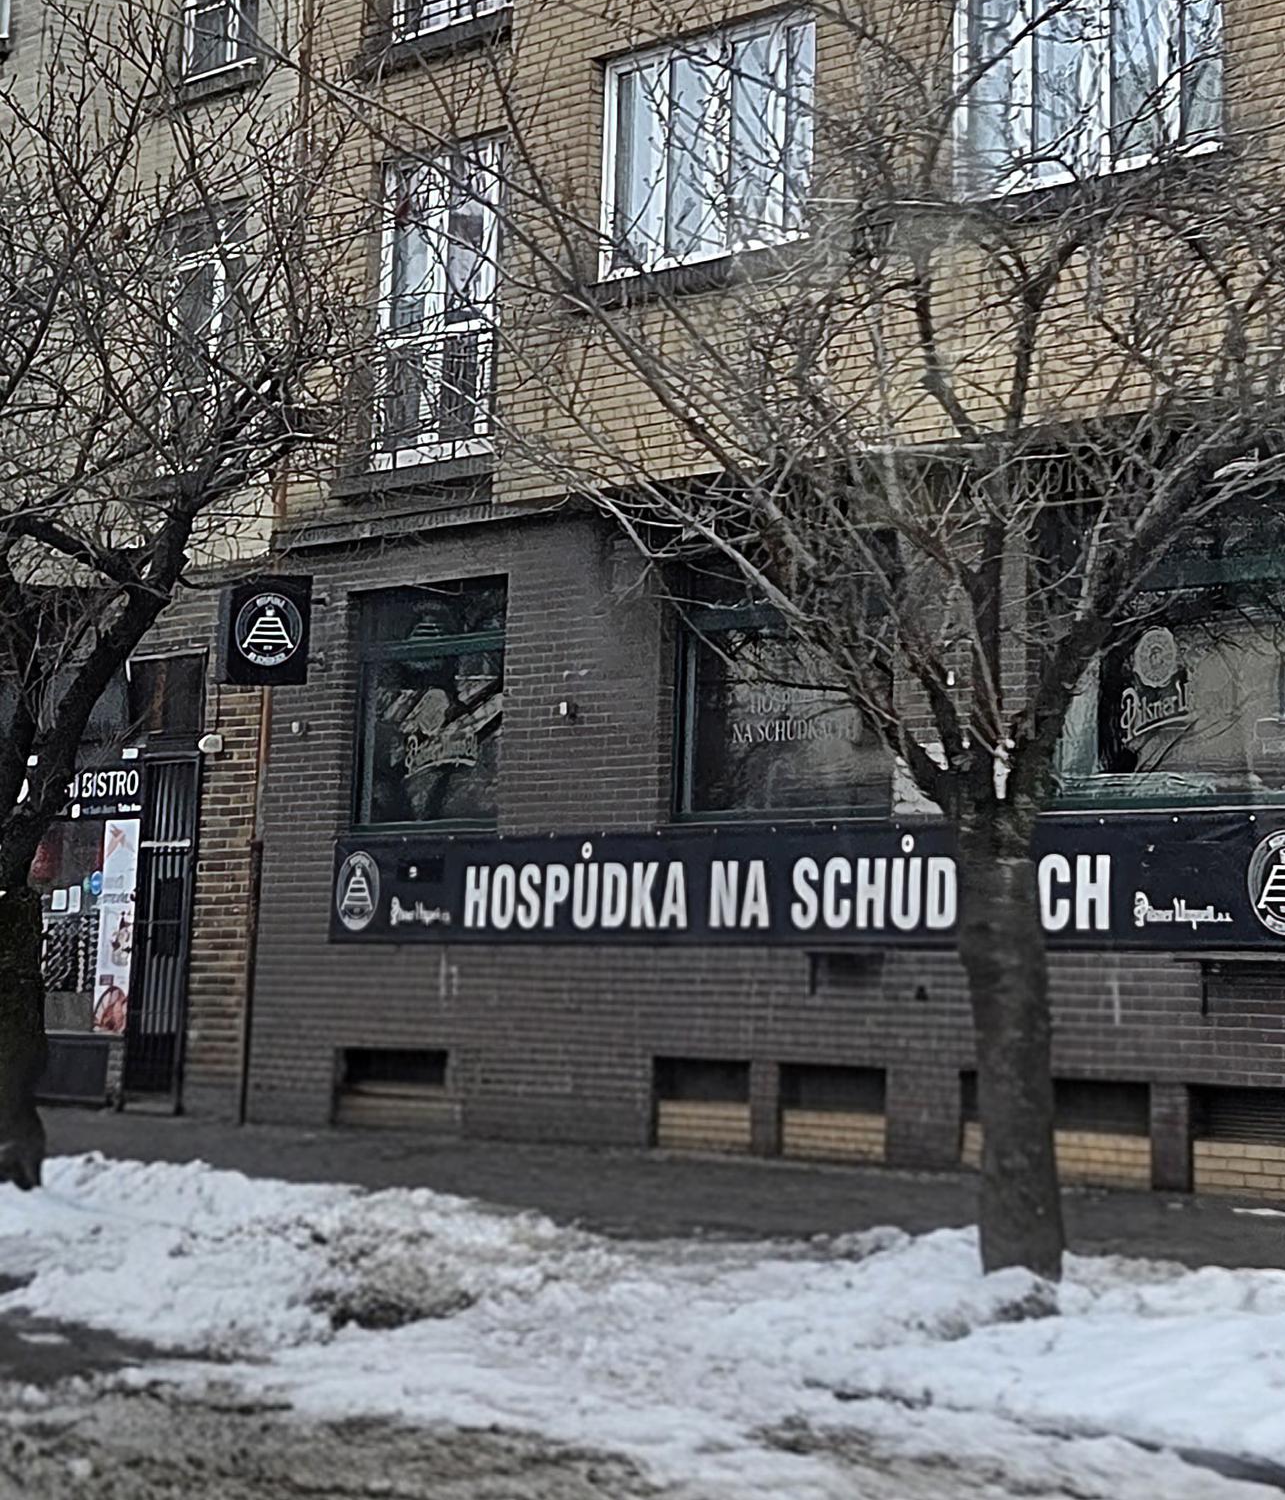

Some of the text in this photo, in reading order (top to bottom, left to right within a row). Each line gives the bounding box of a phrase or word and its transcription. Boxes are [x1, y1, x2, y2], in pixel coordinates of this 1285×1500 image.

[82, 770, 139, 798] BISTRO
[464, 834, 1111, 930] HOSPŮDKA NA SCHŮDCH
